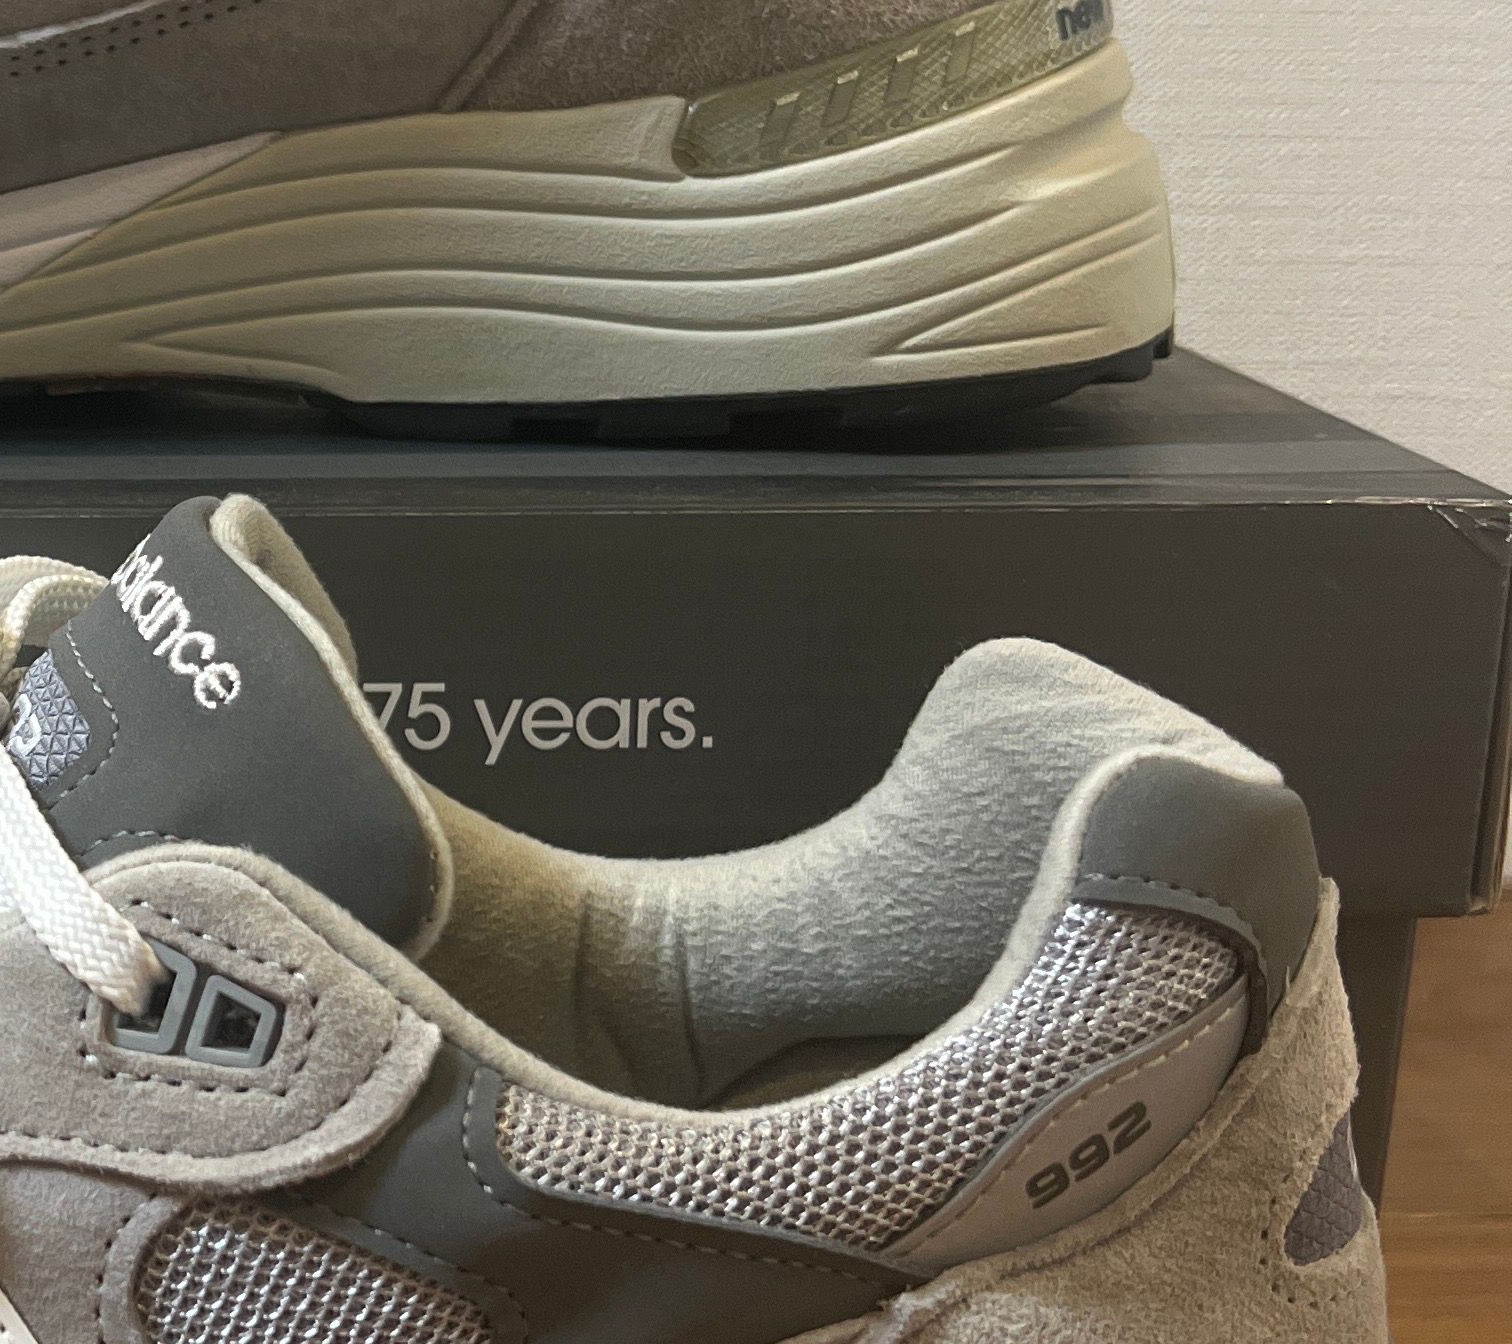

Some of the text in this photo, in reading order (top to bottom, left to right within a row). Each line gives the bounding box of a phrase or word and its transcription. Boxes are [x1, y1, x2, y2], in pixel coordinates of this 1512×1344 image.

[363, 682, 452, 751] 75
[473, 695, 714, 766] years.
[1025, 1100, 1152, 1209] 992
